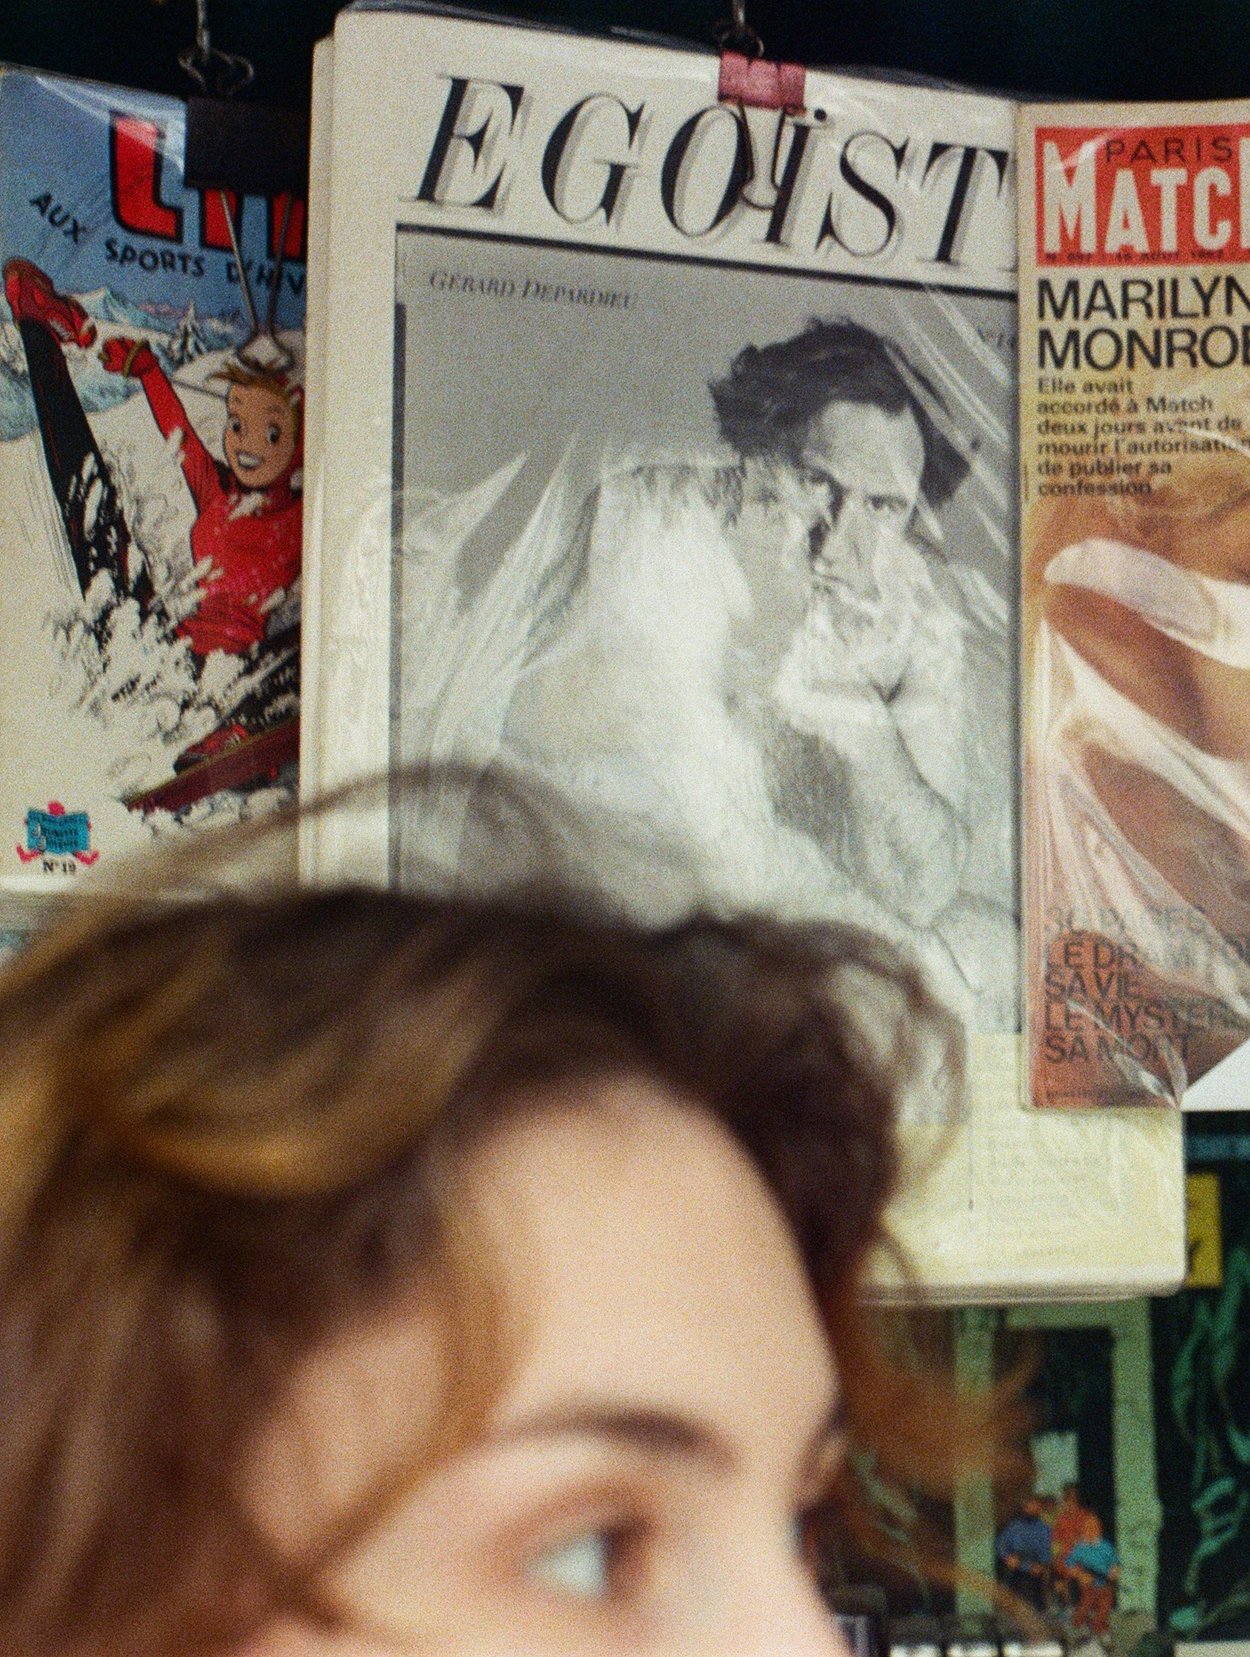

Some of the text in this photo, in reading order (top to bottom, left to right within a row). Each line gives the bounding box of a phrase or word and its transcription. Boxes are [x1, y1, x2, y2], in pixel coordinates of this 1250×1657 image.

[1105, 136, 1233, 166] PARIS
[29, 193, 86, 244] AUX
[105, 238, 206, 278] SPORTS
[1038, 378, 1133, 395] Elle avait
[1037, 396, 1213, 415] accordé à Match
[1037, 415, 1243, 441] deux jours avant de
[1037, 439, 1108, 456] mourir
[1037, 458, 1172, 479] de publier sa
[1037, 478, 1153, 497] confession
